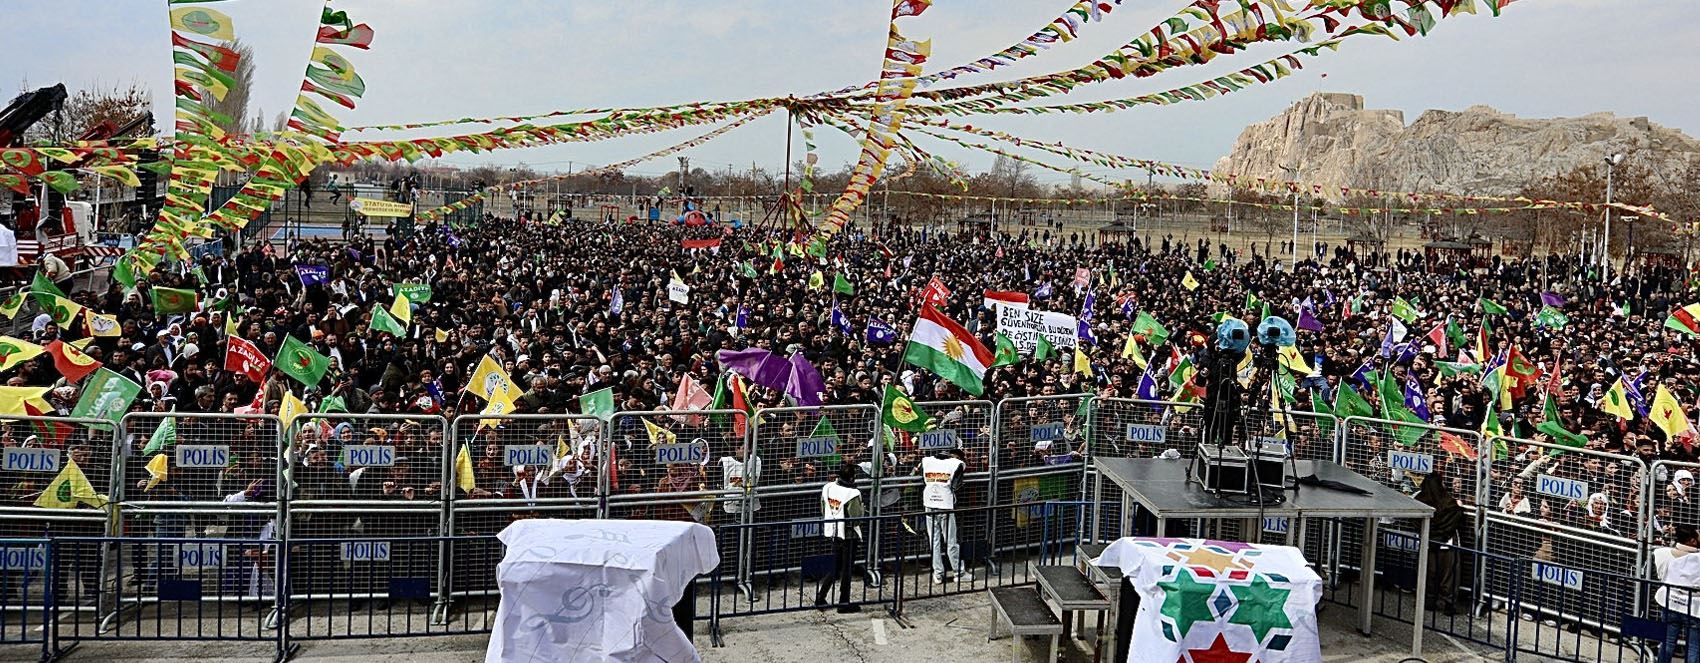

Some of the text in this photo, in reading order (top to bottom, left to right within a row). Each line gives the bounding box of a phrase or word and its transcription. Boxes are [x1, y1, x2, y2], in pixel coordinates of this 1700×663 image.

[1003, 306, 1020, 318] BEN
[923, 430, 952, 447] POLİS
[1131, 424, 1162, 441] POLİS
[183, 447, 225, 466] POLİS
[350, 446, 391, 465] POLİS
[509, 447, 549, 465] POLİS
[658, 445, 700, 462] POLİS
[802, 440, 834, 456] POLİS
[8, 451, 54, 470] POLİS
[1392, 454, 1429, 472] POLİS
[1541, 477, 1582, 499] POLİS
